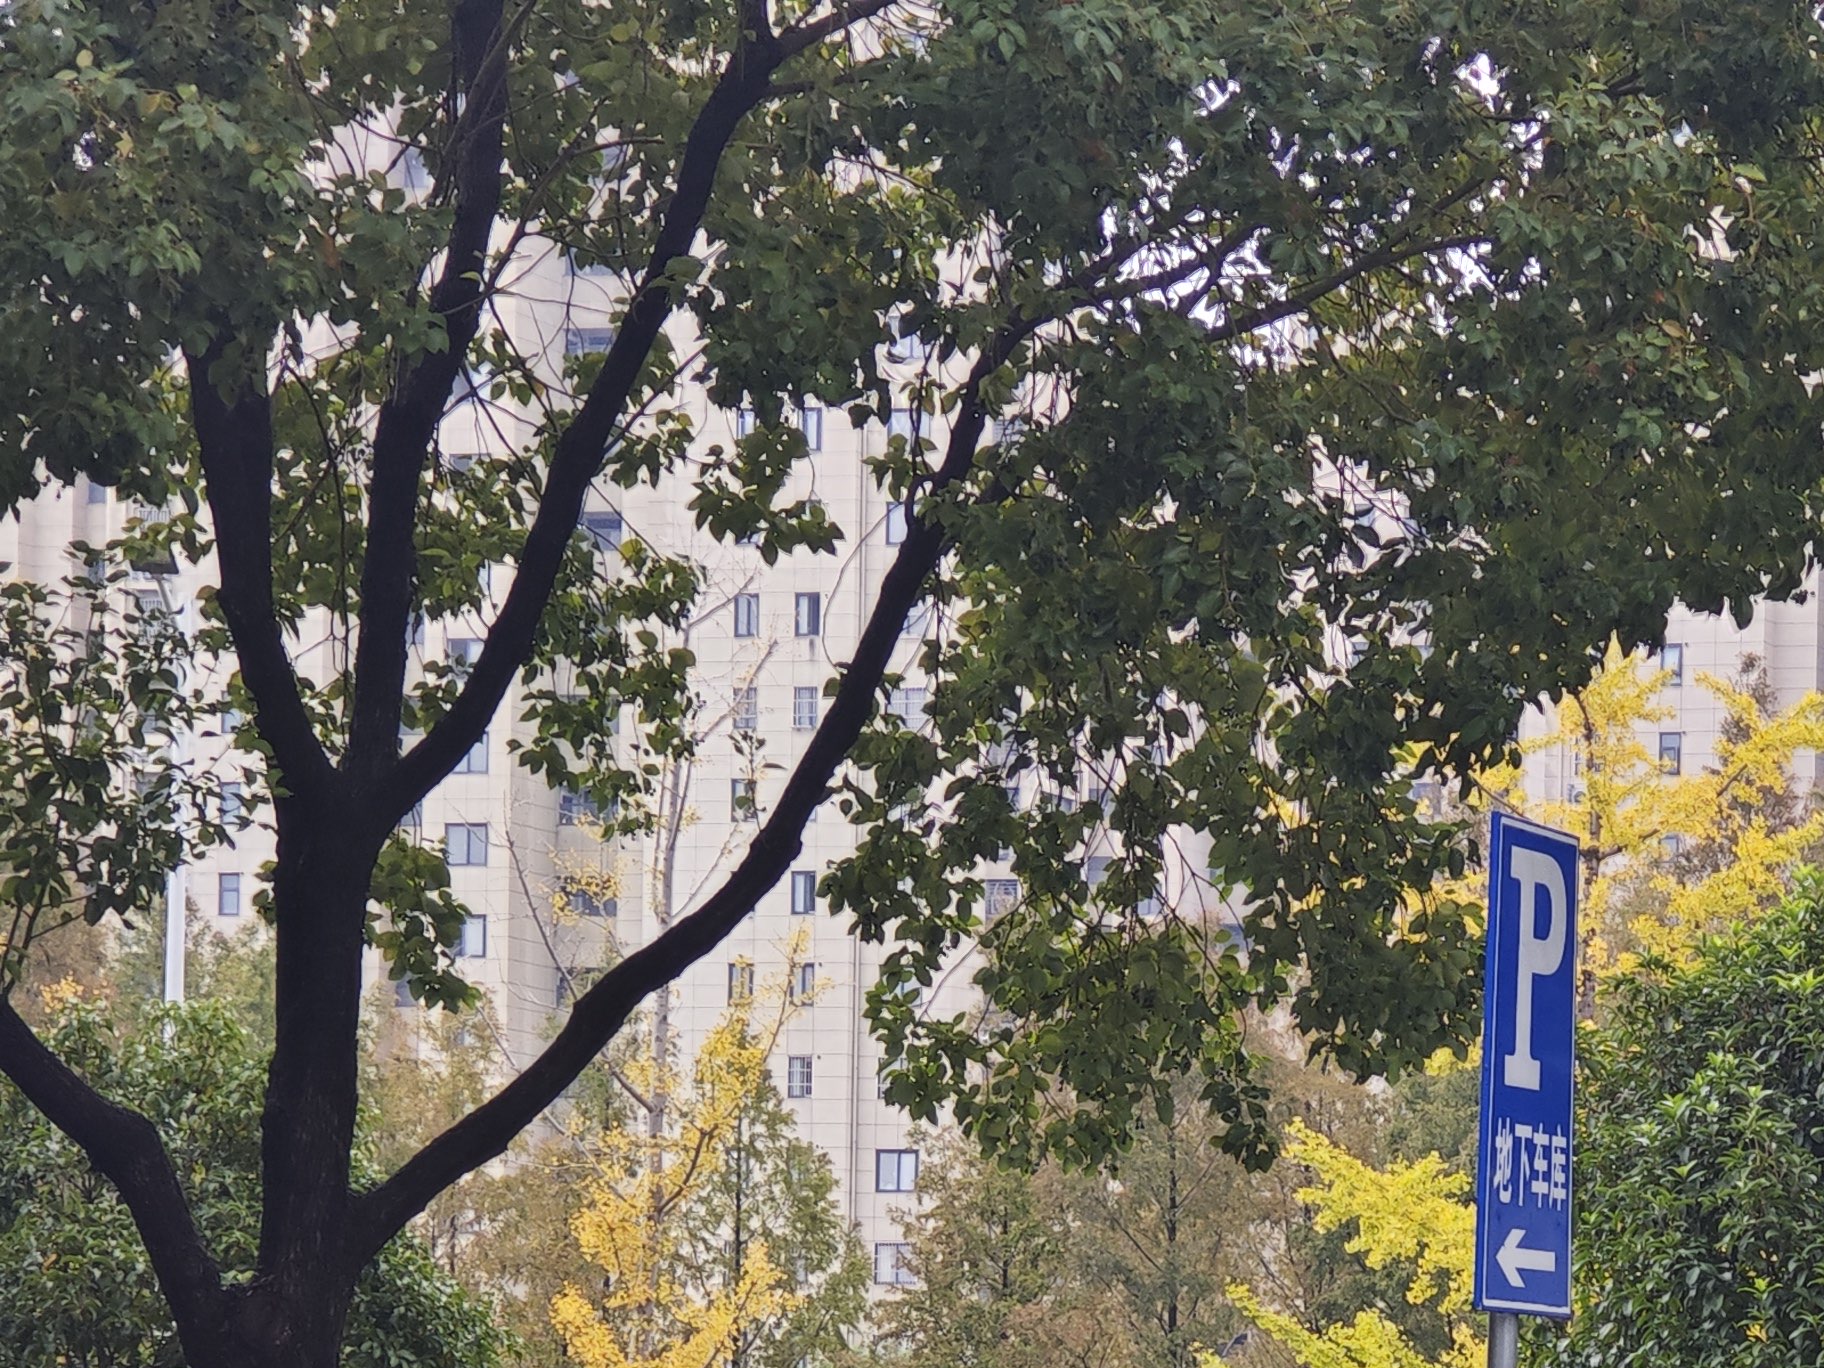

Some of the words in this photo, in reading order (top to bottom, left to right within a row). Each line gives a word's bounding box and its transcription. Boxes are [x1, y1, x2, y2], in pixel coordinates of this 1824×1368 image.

[1504, 845, 1567, 1090] P
[1493, 1117, 1567, 1211] 地下车库
